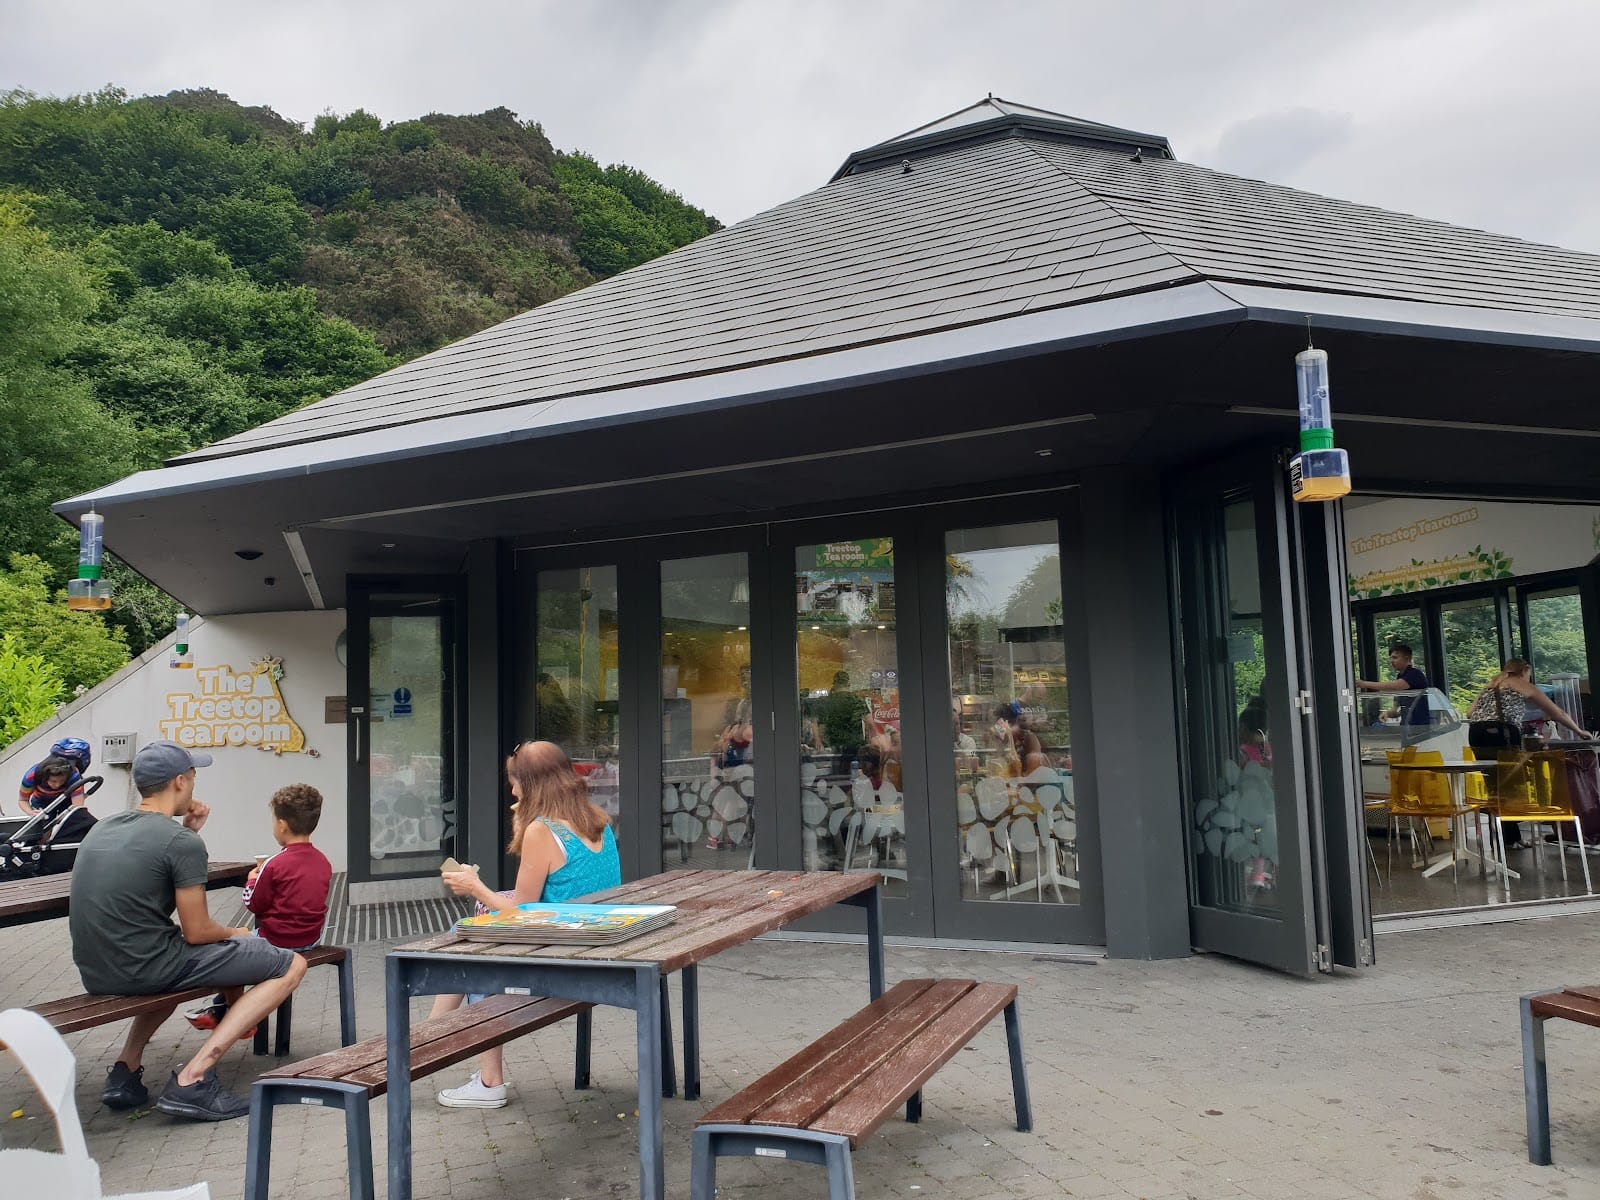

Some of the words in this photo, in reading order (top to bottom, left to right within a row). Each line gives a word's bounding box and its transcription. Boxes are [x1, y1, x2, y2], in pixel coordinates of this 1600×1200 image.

[1351, 538, 1374, 555] The
[1371, 526, 1418, 549] Treetop
[1416, 507, 1479, 537] Tearooms
[825, 543, 862, 553] Treetop
[198, 665, 252, 694] The
[168, 695, 281, 722] Treetop
